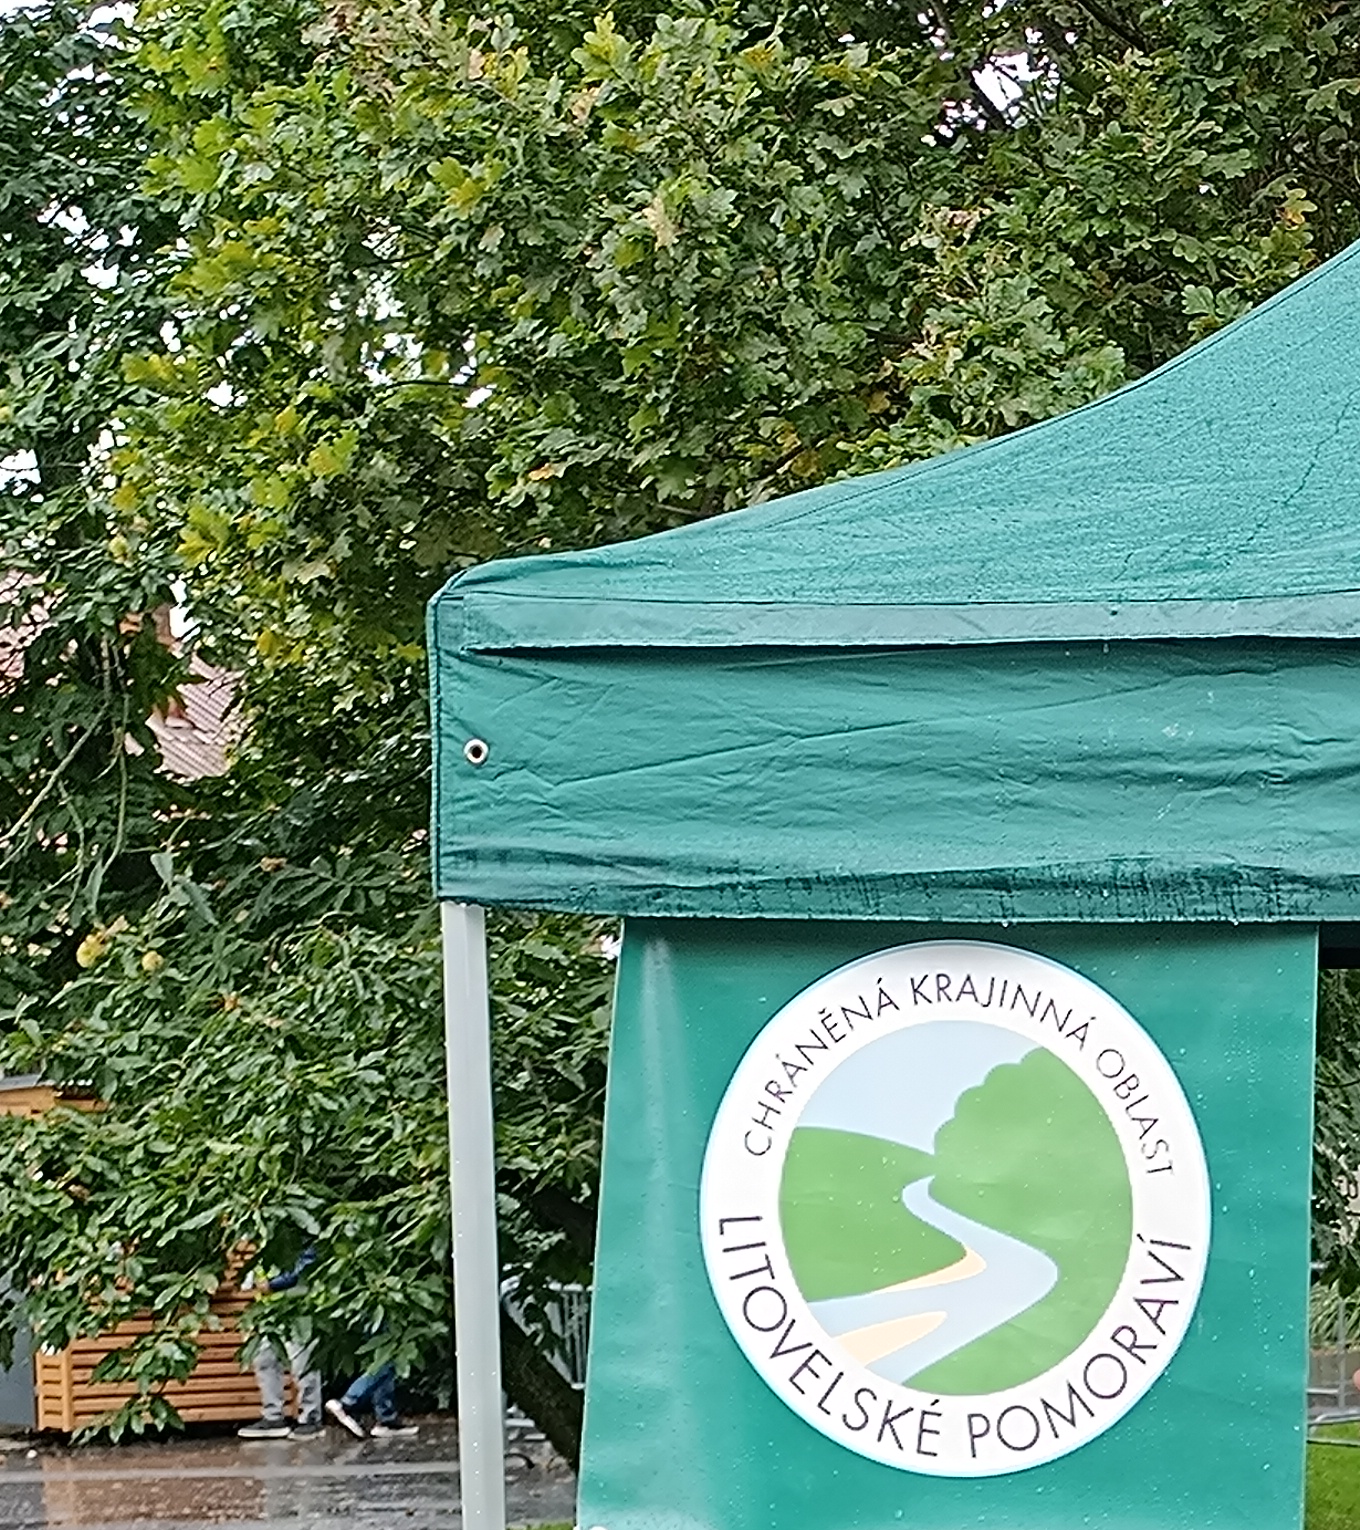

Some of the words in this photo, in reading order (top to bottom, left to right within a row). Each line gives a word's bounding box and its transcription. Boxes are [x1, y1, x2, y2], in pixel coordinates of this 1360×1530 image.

[744, 977, 900, 1156] CHRÁNĚNÁ
[910, 973, 1097, 1051] KRAJINNÁ
[1097, 1048, 1172, 1175] OBLAST
[718, 1214, 941, 1457] LITOVELSKÉ
[968, 1233, 1192, 1458] POMORAVÍ
